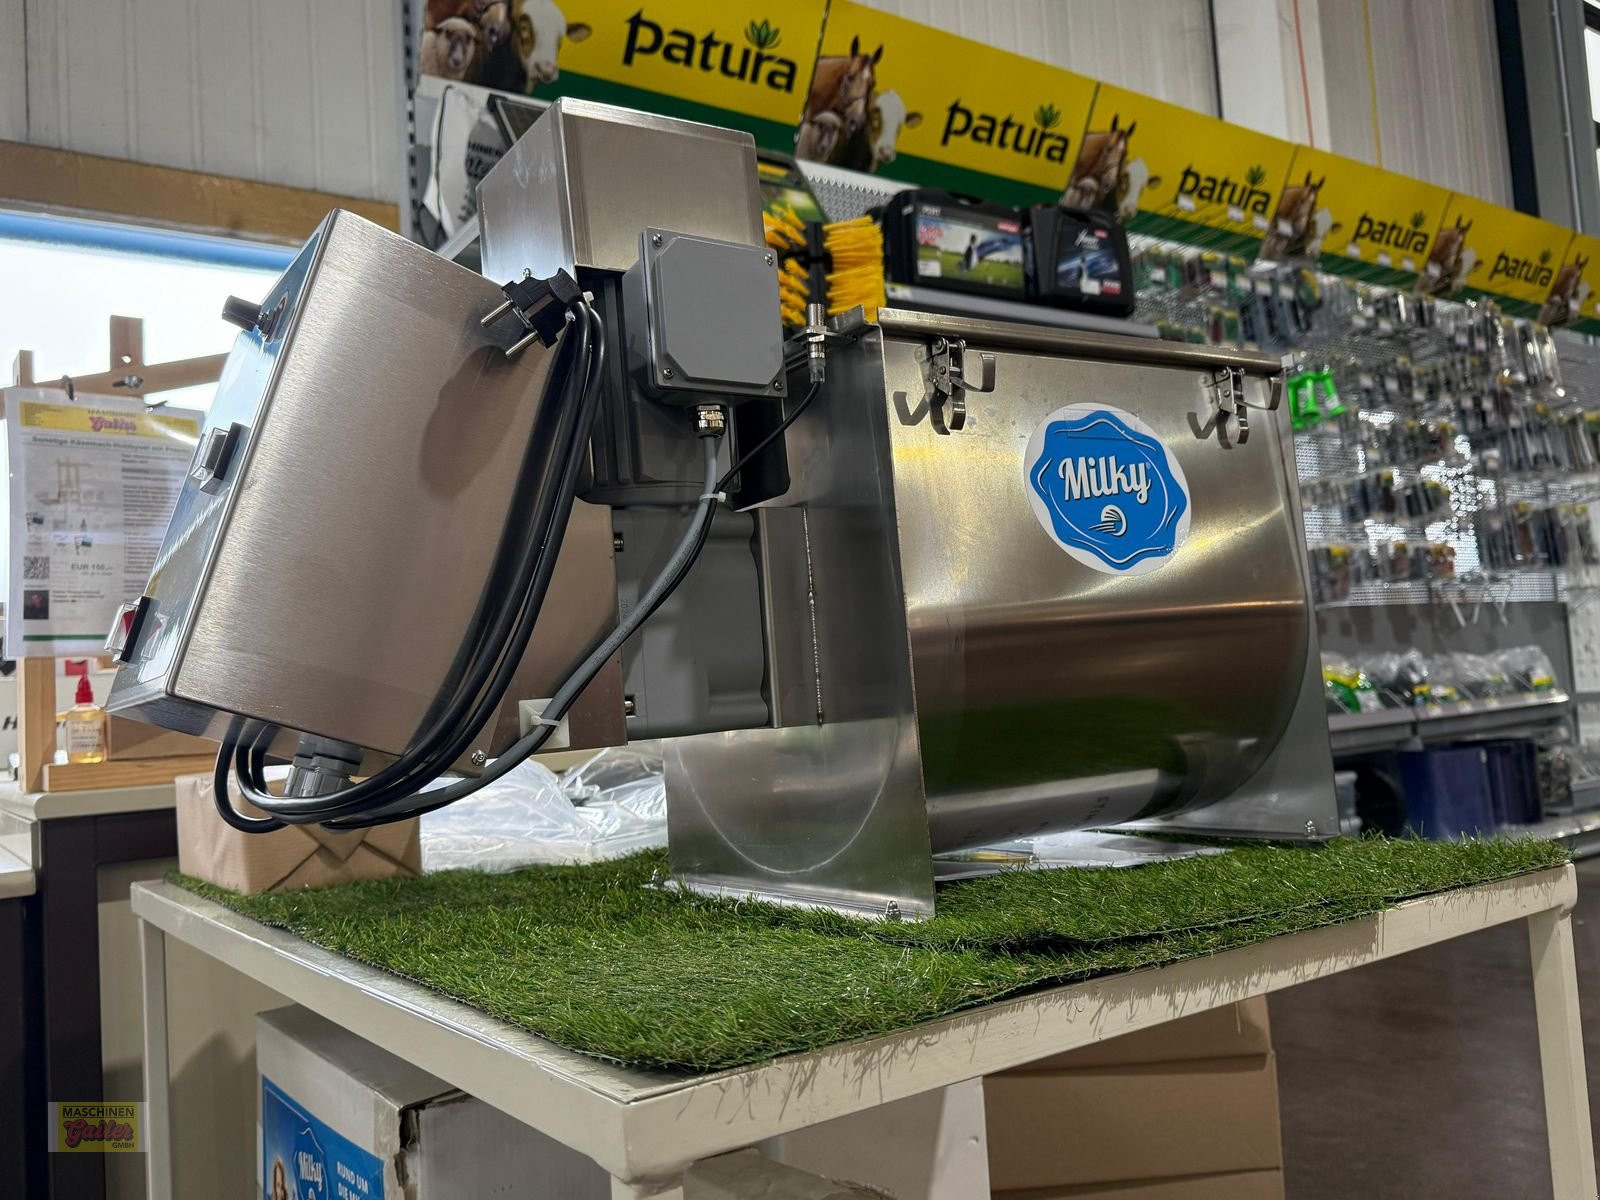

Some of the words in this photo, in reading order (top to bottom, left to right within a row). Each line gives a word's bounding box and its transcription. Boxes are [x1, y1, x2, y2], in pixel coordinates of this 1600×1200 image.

[622, 8, 797, 94] patura
[941, 98, 1069, 164] patura
[1174, 164, 1270, 214] patura
[1352, 211, 1429, 253] patura
[1489, 251, 1553, 287] patura
[1058, 456, 1151, 504] Milky
[298, 1151, 323, 1192] Milky
[336, 1161, 356, 1185] RUND
[356, 1174, 369, 1195] UM
